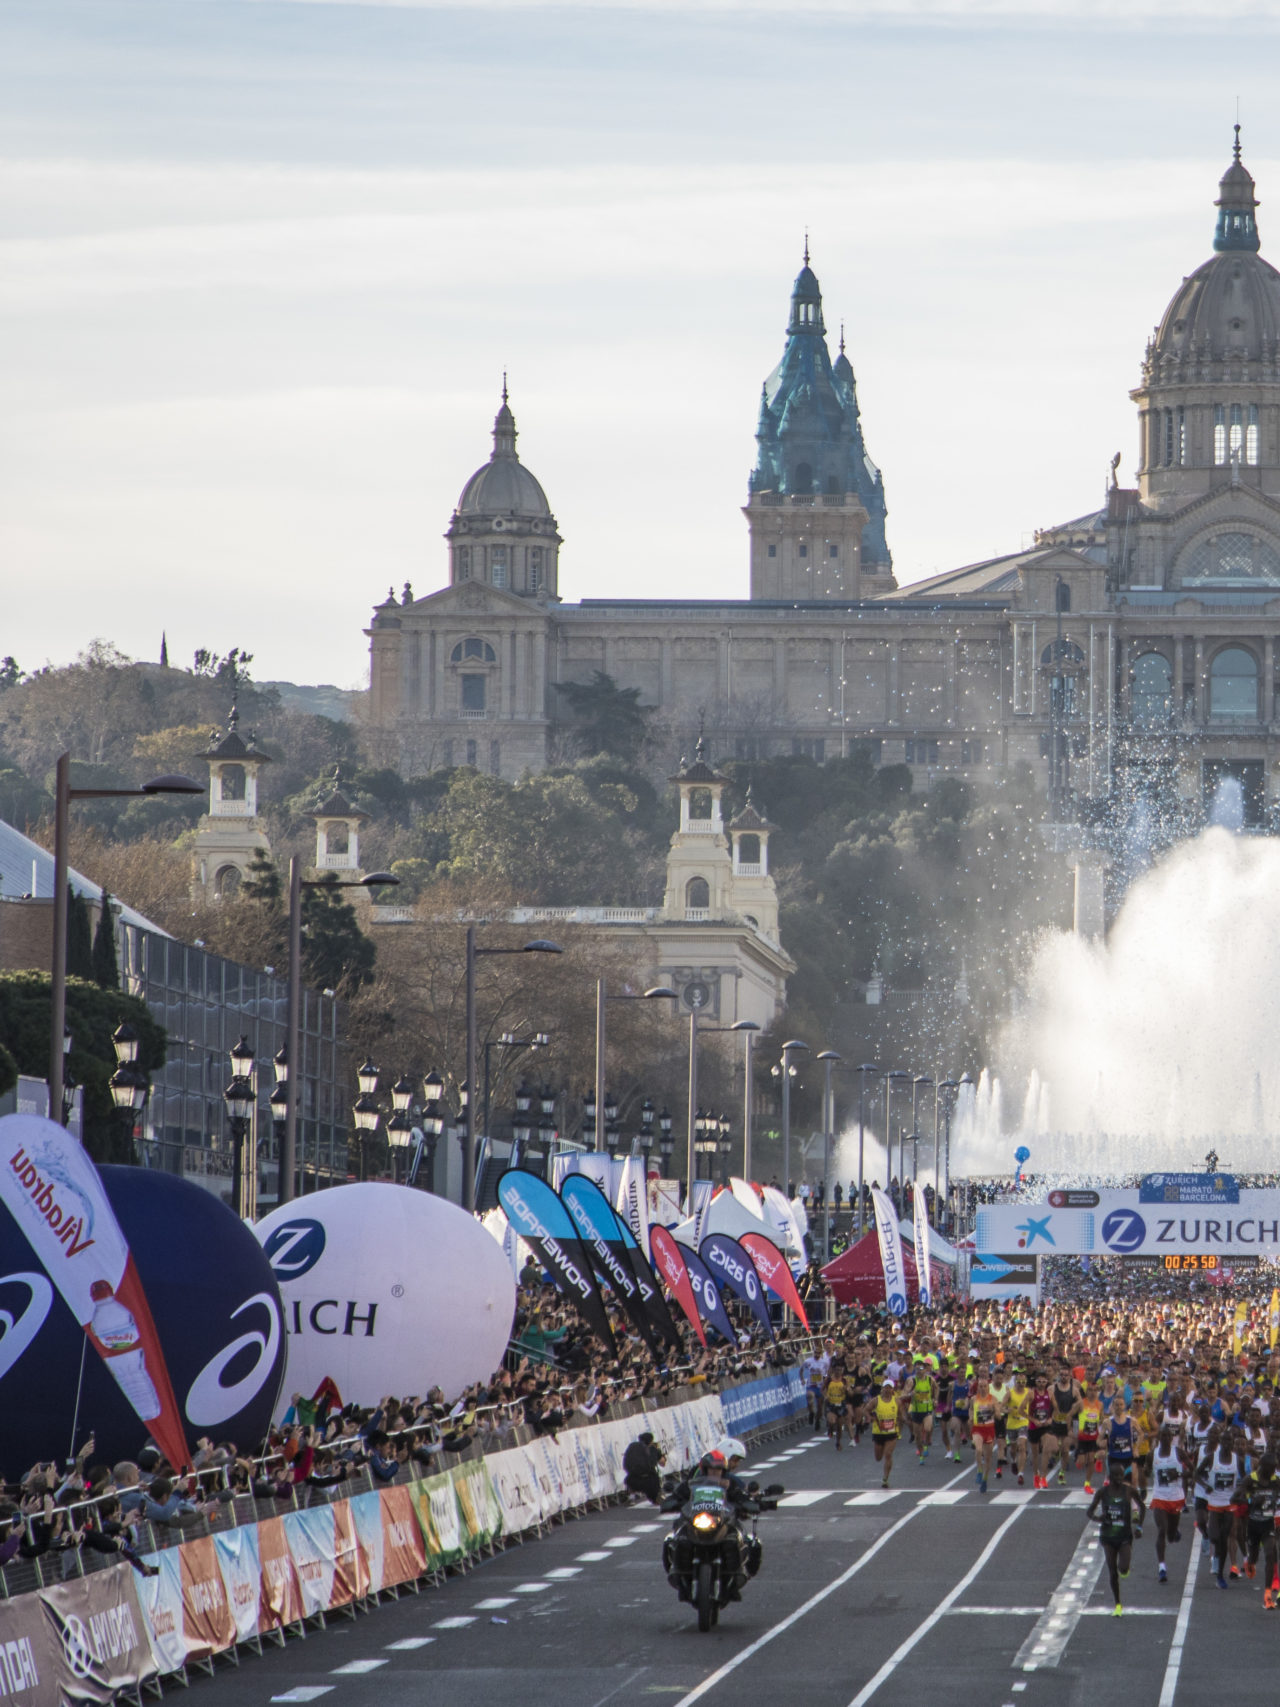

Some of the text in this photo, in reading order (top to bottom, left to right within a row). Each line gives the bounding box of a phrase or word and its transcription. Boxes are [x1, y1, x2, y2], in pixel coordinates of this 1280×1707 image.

[1180, 1194, 1227, 1202] BARCELONA
[1155, 1219, 1279, 1243] ZURICH
[971, 1263, 1034, 1272] POWERADE
[1165, 1255, 1216, 1269] 00 25 58
[285, 1299, 379, 1337] ICH
